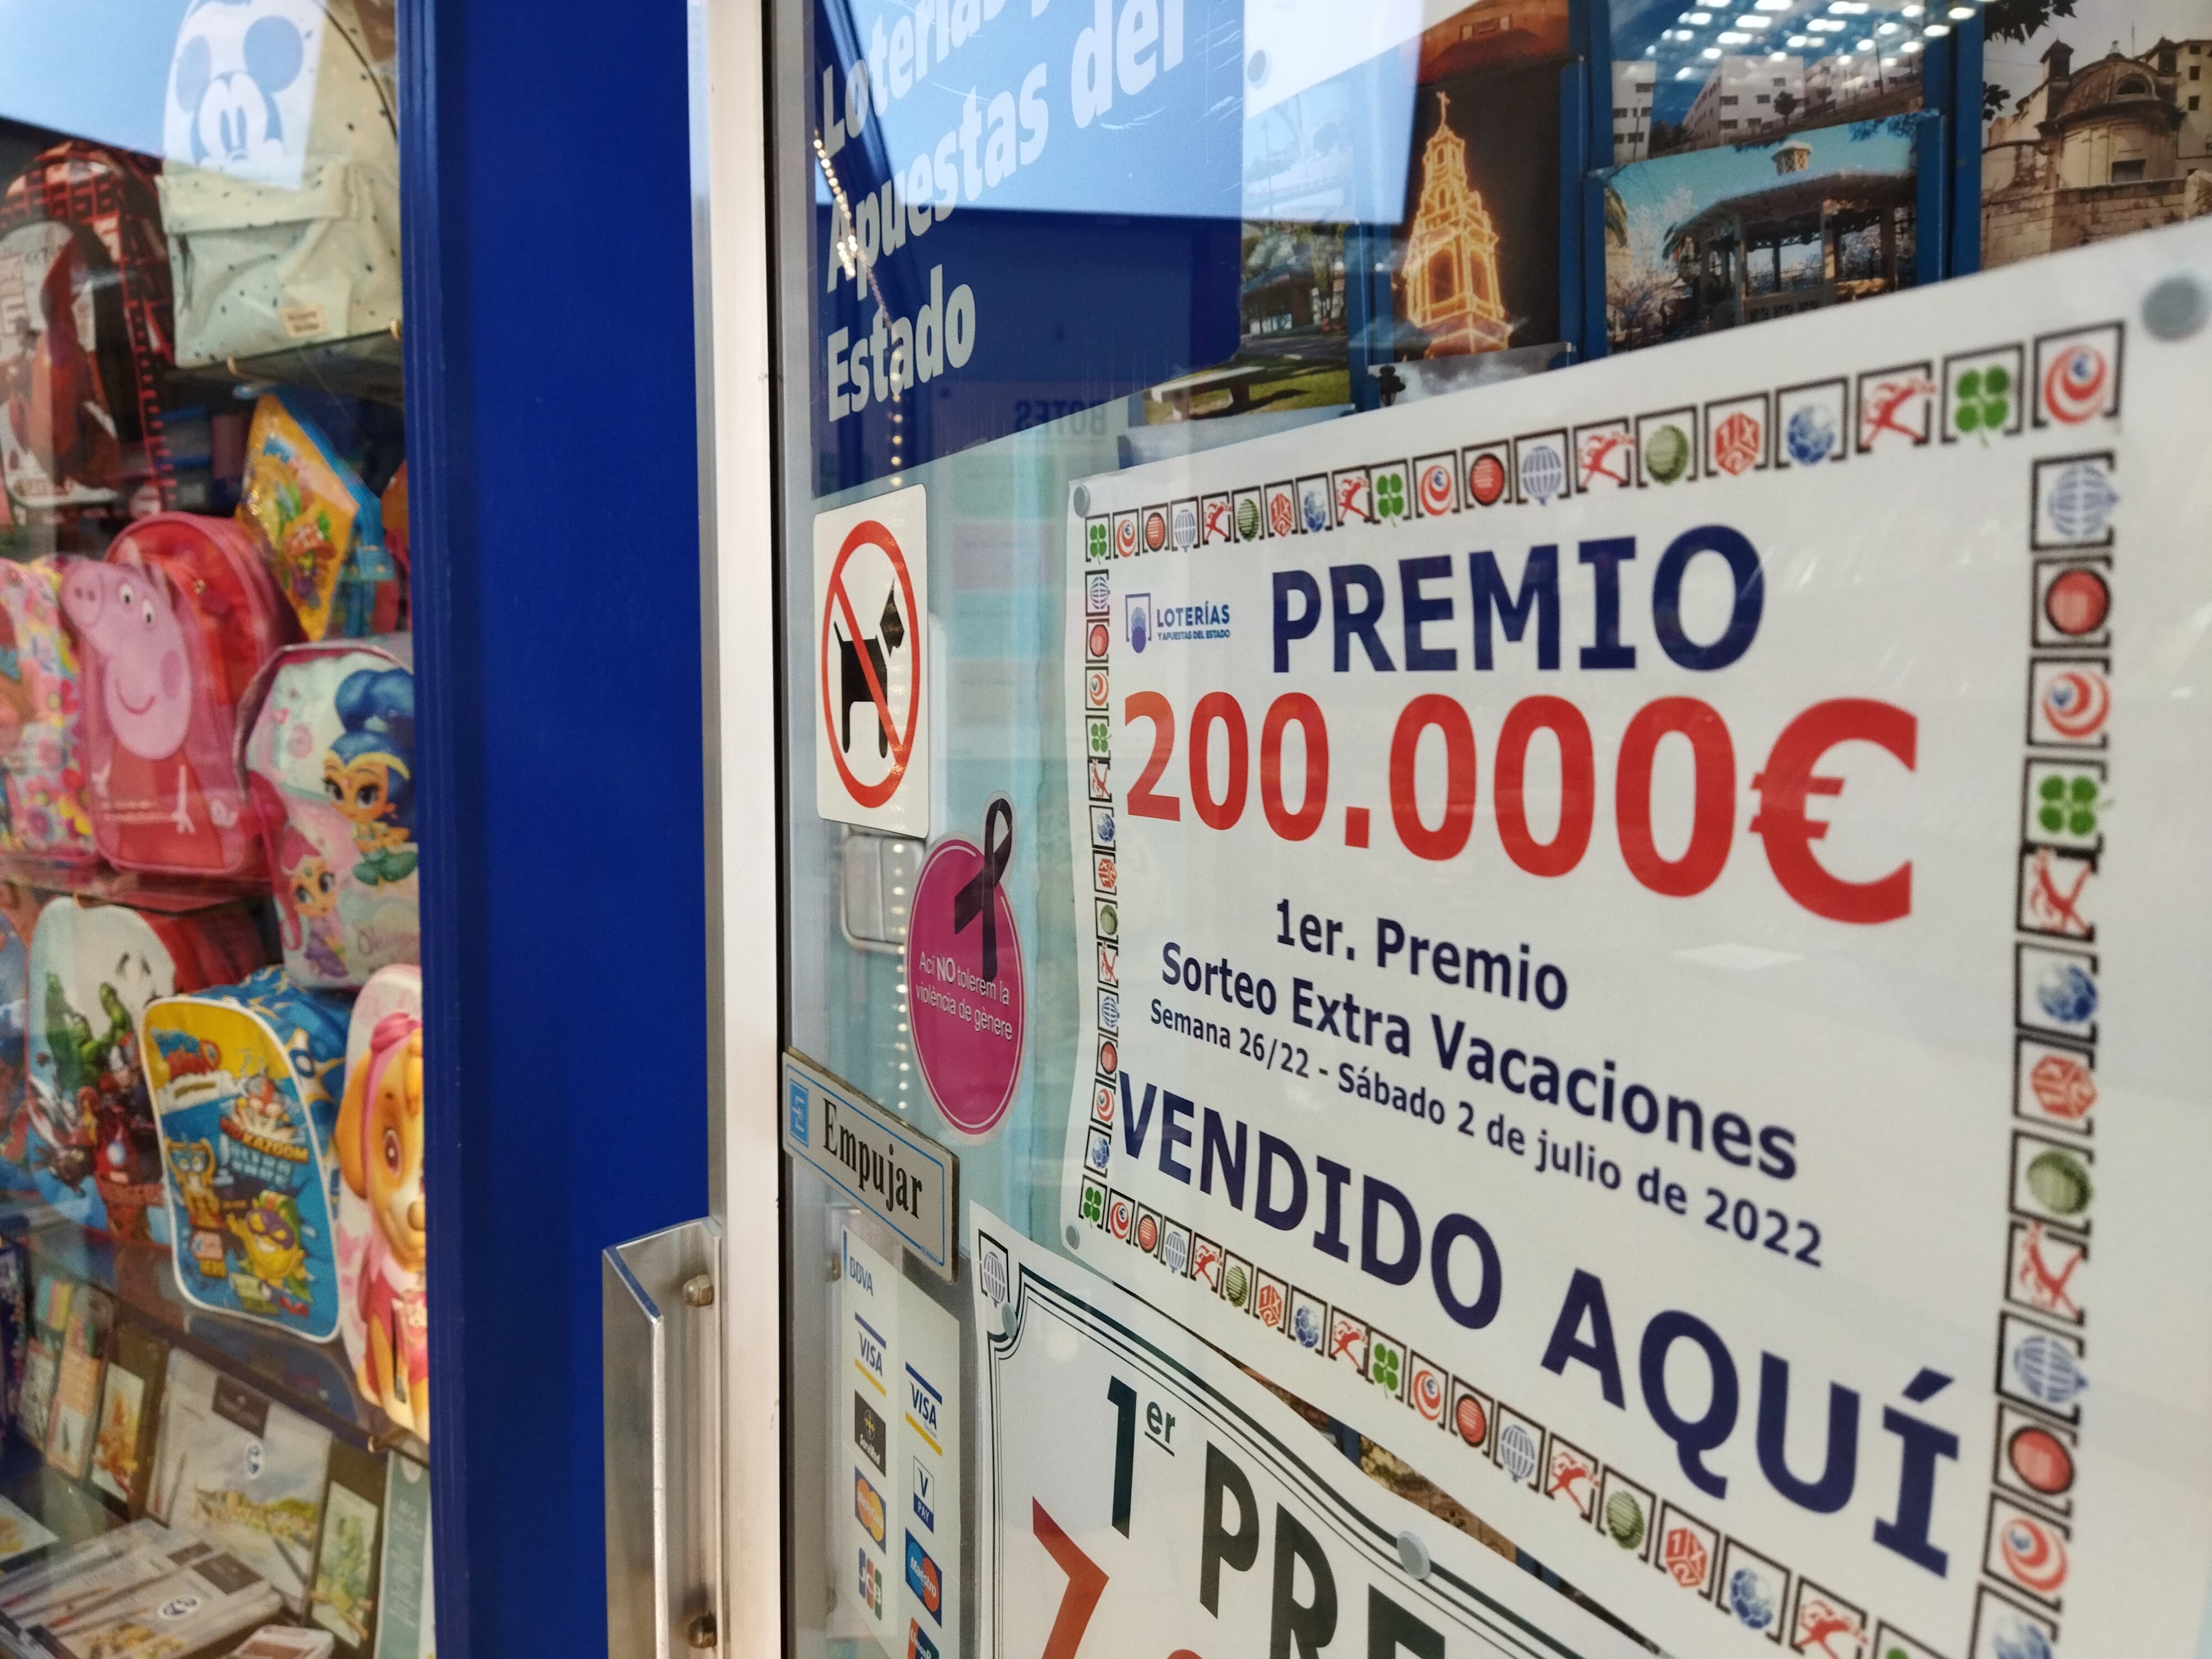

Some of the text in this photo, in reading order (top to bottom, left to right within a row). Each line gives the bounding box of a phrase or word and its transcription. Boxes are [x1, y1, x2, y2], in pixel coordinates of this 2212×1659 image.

[823, 0, 1005, 156] Lotería
[827, 63, 1048, 301] Apuestas
[827, 264, 975, 422] Estado
[1157, 601, 1230, 627] LOTERÍAS
[1272, 524, 1766, 674] PREMIO
[1163, 630, 1192, 640] APUESTAS
[1193, 630, 1204, 639] DEL
[1206, 629, 1230, 639] ESTADO
[1124, 691, 1917, 925] 200.000€
[936, 956, 956, 983] NO
[957, 966, 997, 1000] tolerem
[999, 980, 1009, 1005] la
[1276, 899, 1569, 1012] 1er. Premio
[916, 981, 1013, 1040] violència de gènere
[1161, 941, 1798, 1182] Sorteo Extra Vacaciones
[823, 1097, 922, 1220] Empujar
[1150, 998, 1232, 1051] Semana
[1238, 1032, 1310, 1079] 26/22
[1338, 1061, 1446, 1127] Sábado
[1458, 1102, 1476, 1136] 2
[1486, 1115, 1525, 1157] de
[1535, 1133, 1622, 1192] julio
[1637, 1167, 1688, 1217] de
[1704, 1187, 1825, 1267] 2022
[850, 1255, 874, 1296] BBVA
[858, 1330, 883, 1377] VISA
[1118, 1070, 1961, 1580] VENDIDO AQUÍ
[910, 1381, 937, 1431] VISA
[917, 1467, 928, 1498] V
[918, 1501, 930, 1523] PAY
[910, 1556, 936, 1597] Maestro
[910, 1627, 932, 1659] UnionP
